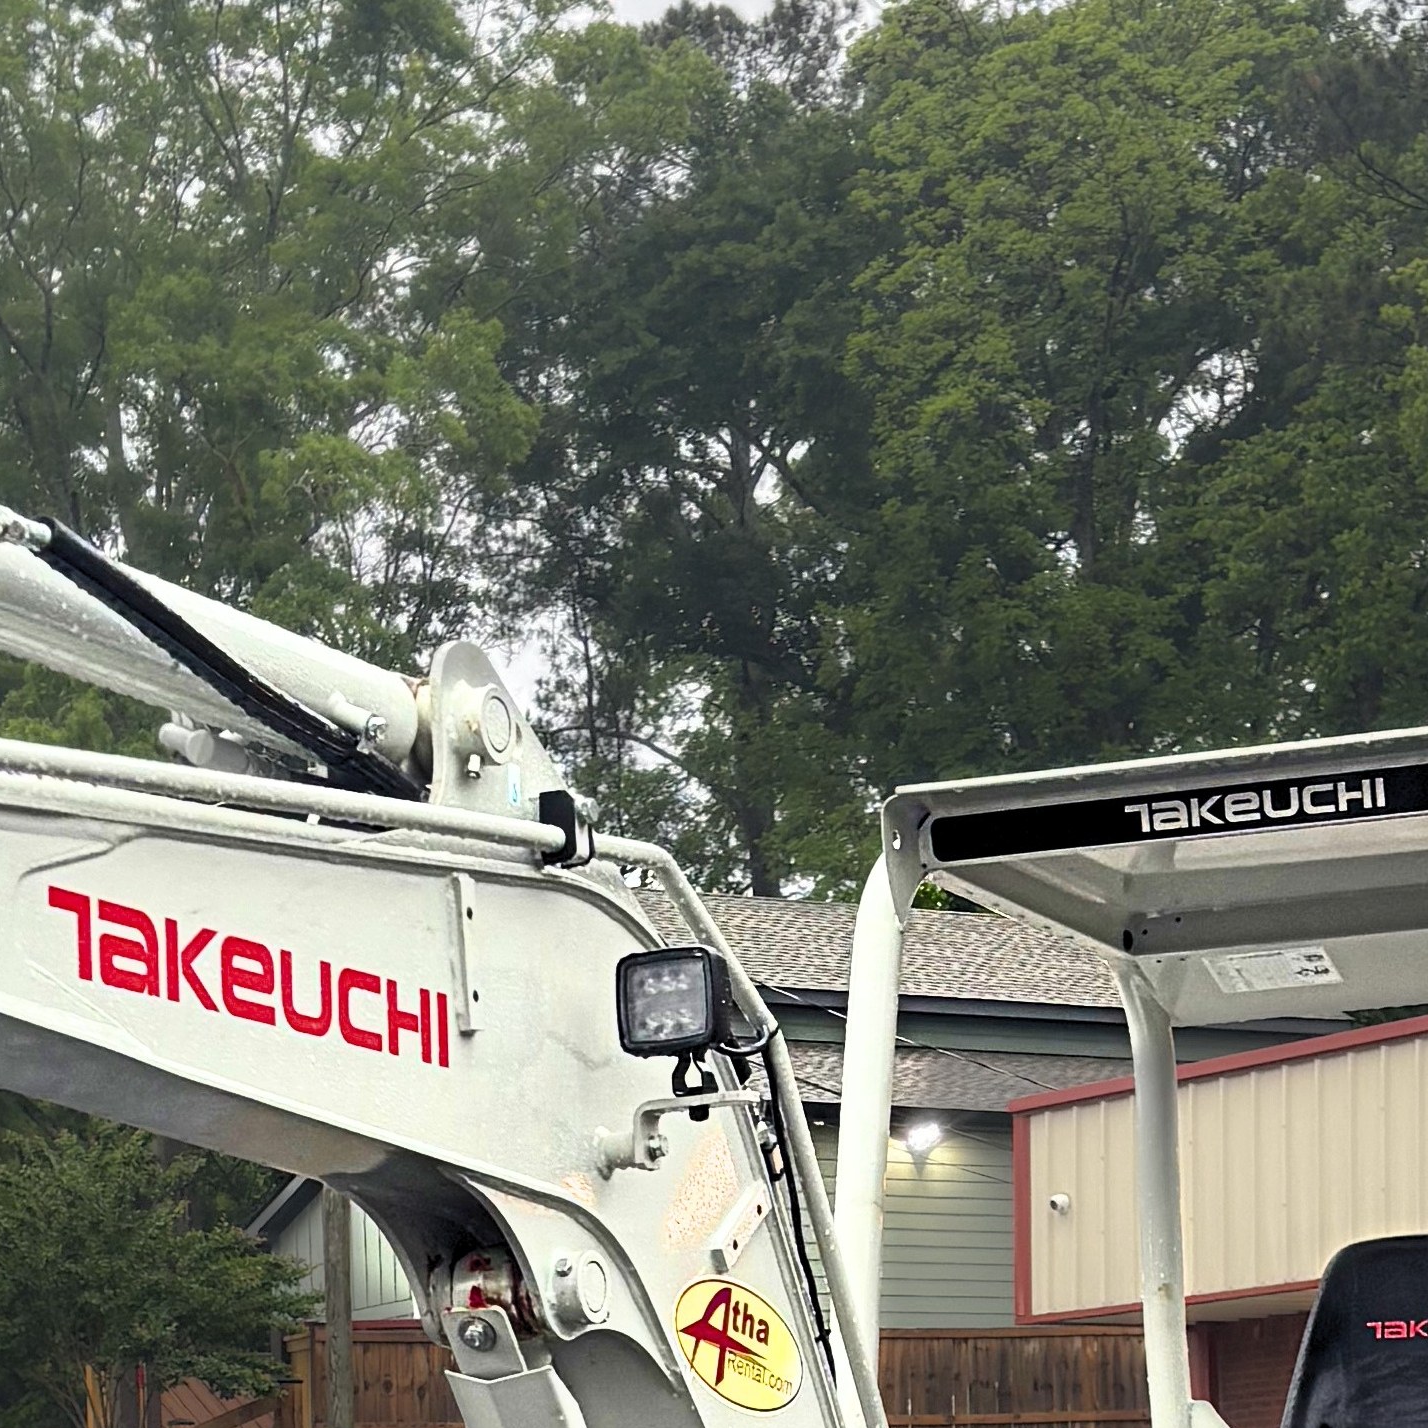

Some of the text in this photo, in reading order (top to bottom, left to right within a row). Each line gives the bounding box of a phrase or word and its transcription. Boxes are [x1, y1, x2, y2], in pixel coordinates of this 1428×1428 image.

[1124, 776, 1387, 833] TAKEUCHI
[48, 885, 449, 1068] TAKEUCHI
[679, 1287, 769, 1387] Atha
